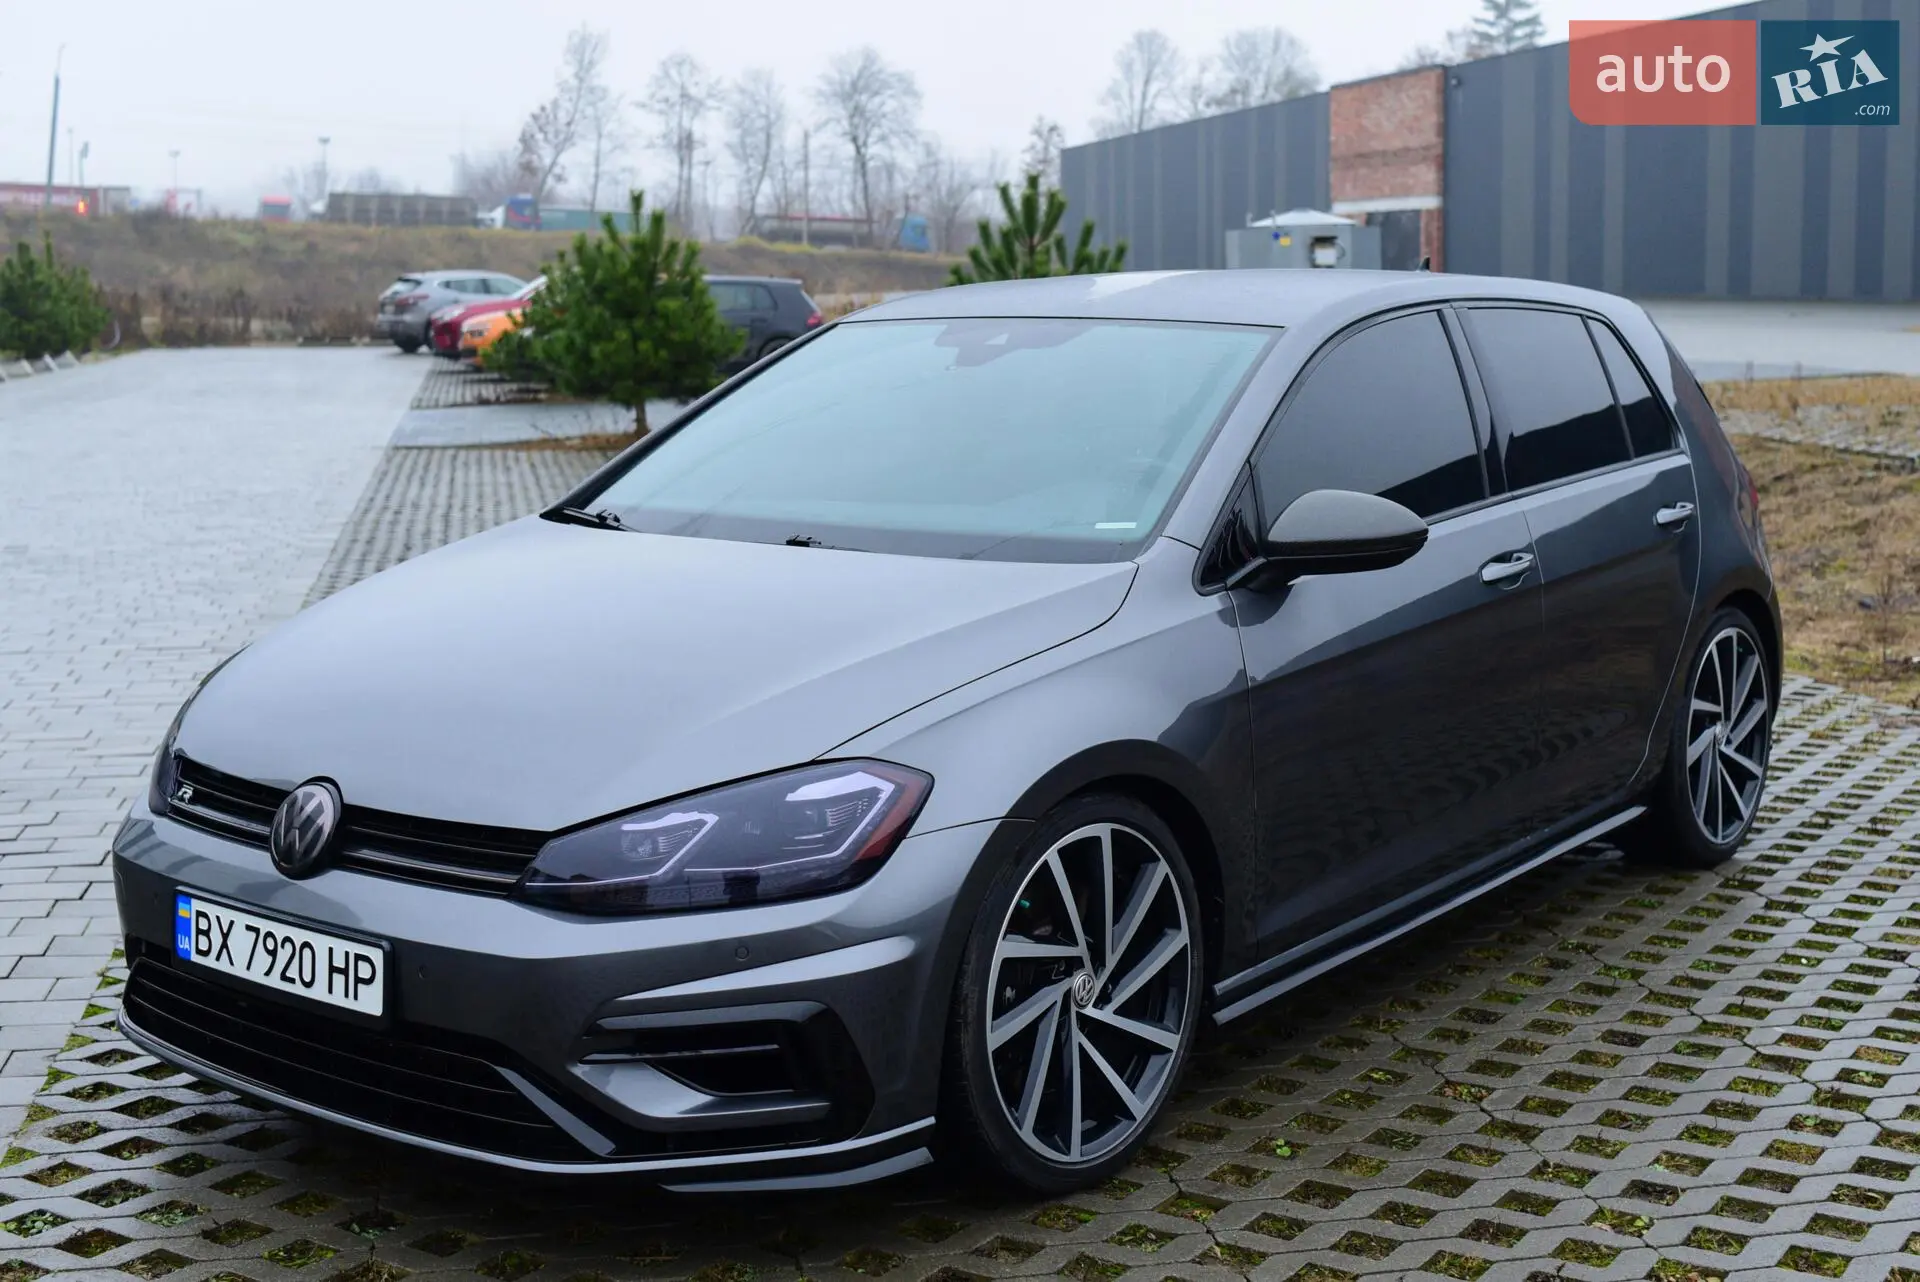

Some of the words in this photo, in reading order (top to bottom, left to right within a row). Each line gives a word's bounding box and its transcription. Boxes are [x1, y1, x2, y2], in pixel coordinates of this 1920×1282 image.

[178, 933, 191, 951] UA
[195, 909, 235, 967] BX
[245, 923, 316, 989] 7920
[328, 946, 377, 1001] HP
